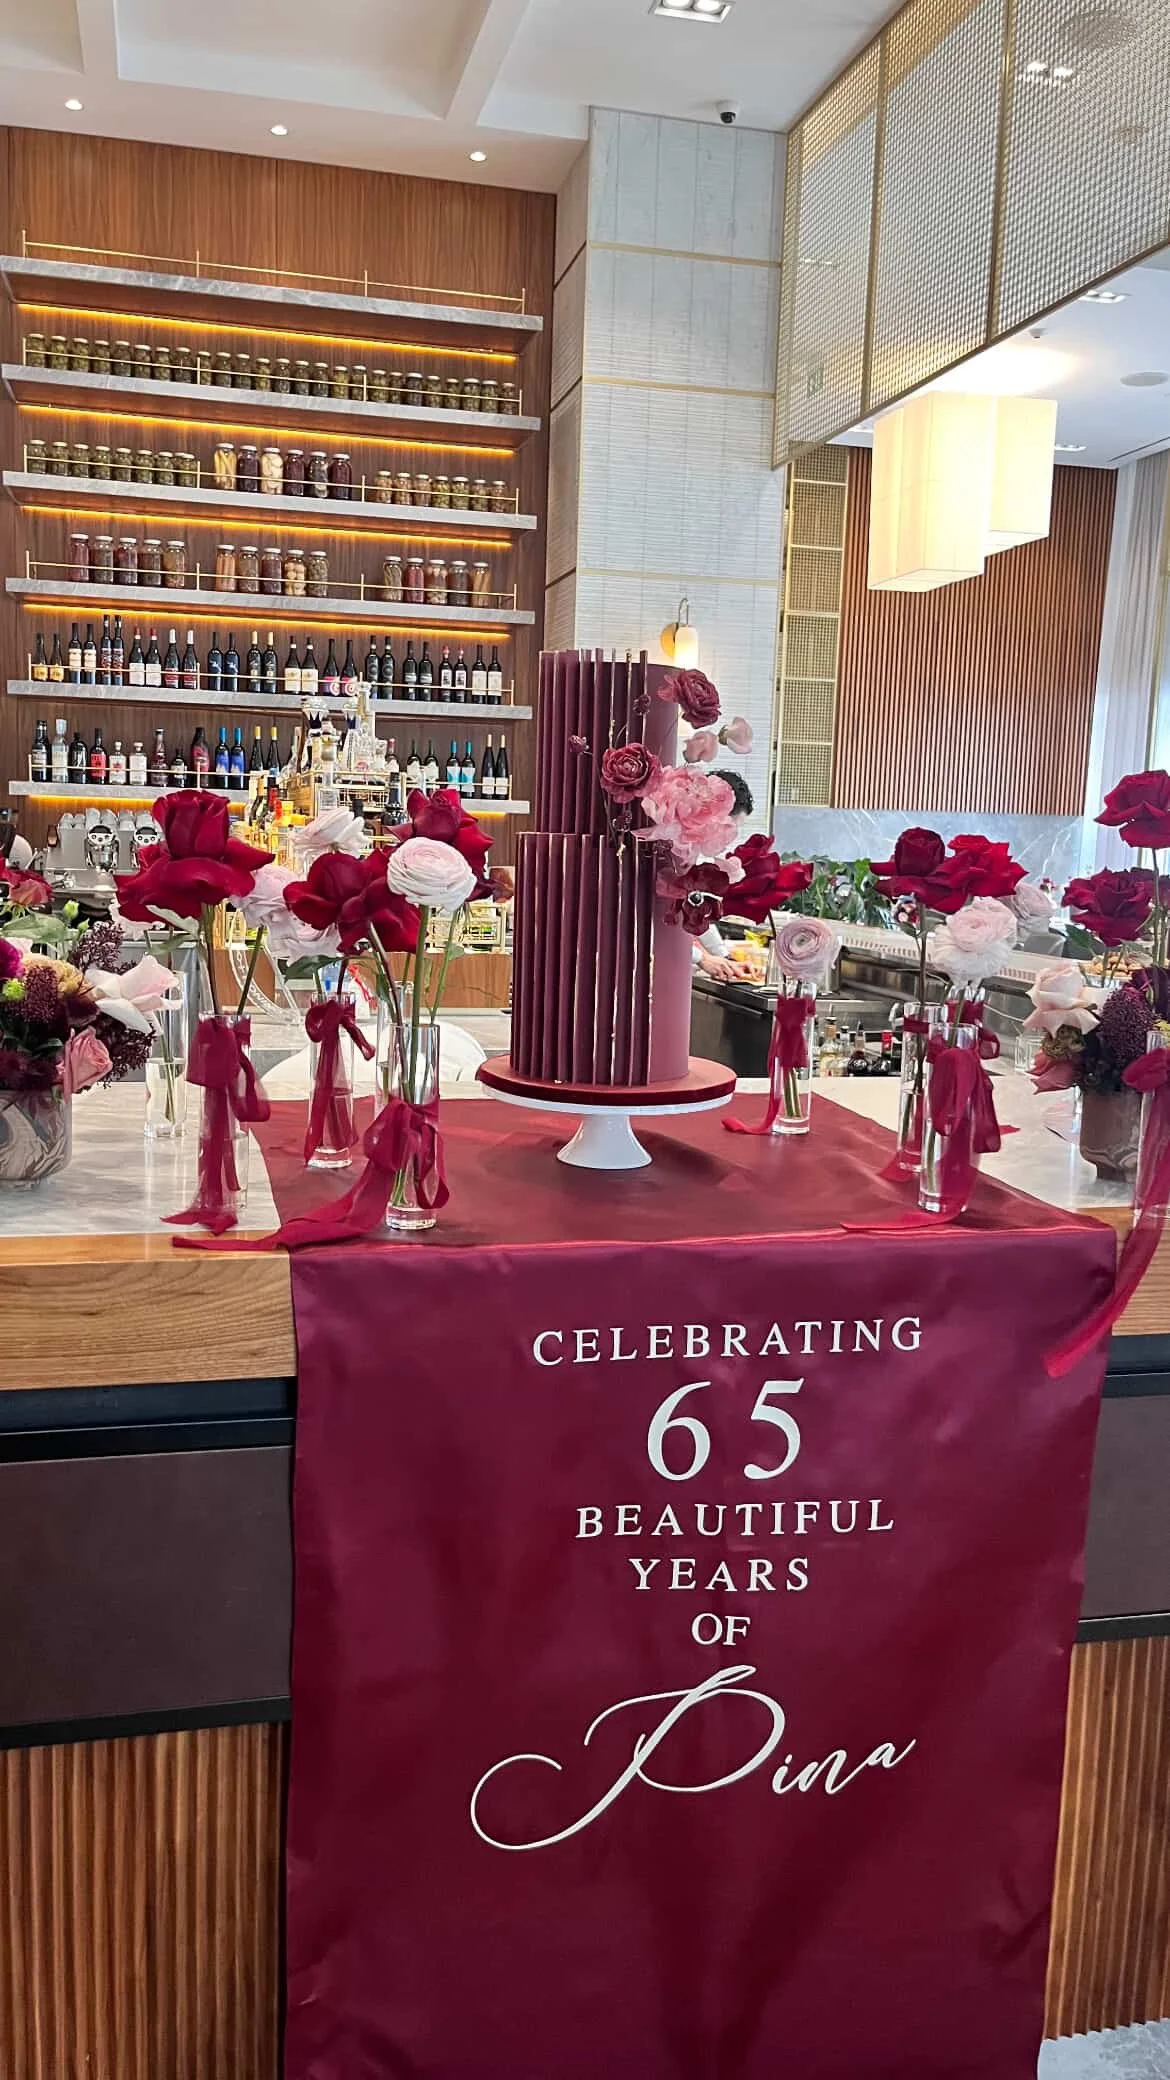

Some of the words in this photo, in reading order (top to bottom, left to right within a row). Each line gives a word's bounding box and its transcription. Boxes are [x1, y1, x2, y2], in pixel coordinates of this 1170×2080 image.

[532, 1317, 923, 1366] CELEBRATING
[646, 1378, 805, 1482] 65
[575, 1499, 895, 1539] BEAUTIFUL
[628, 1558, 809, 1592] YEARS
[691, 1613, 751, 1646] OF
[469, 1664, 916, 1851] Pina
